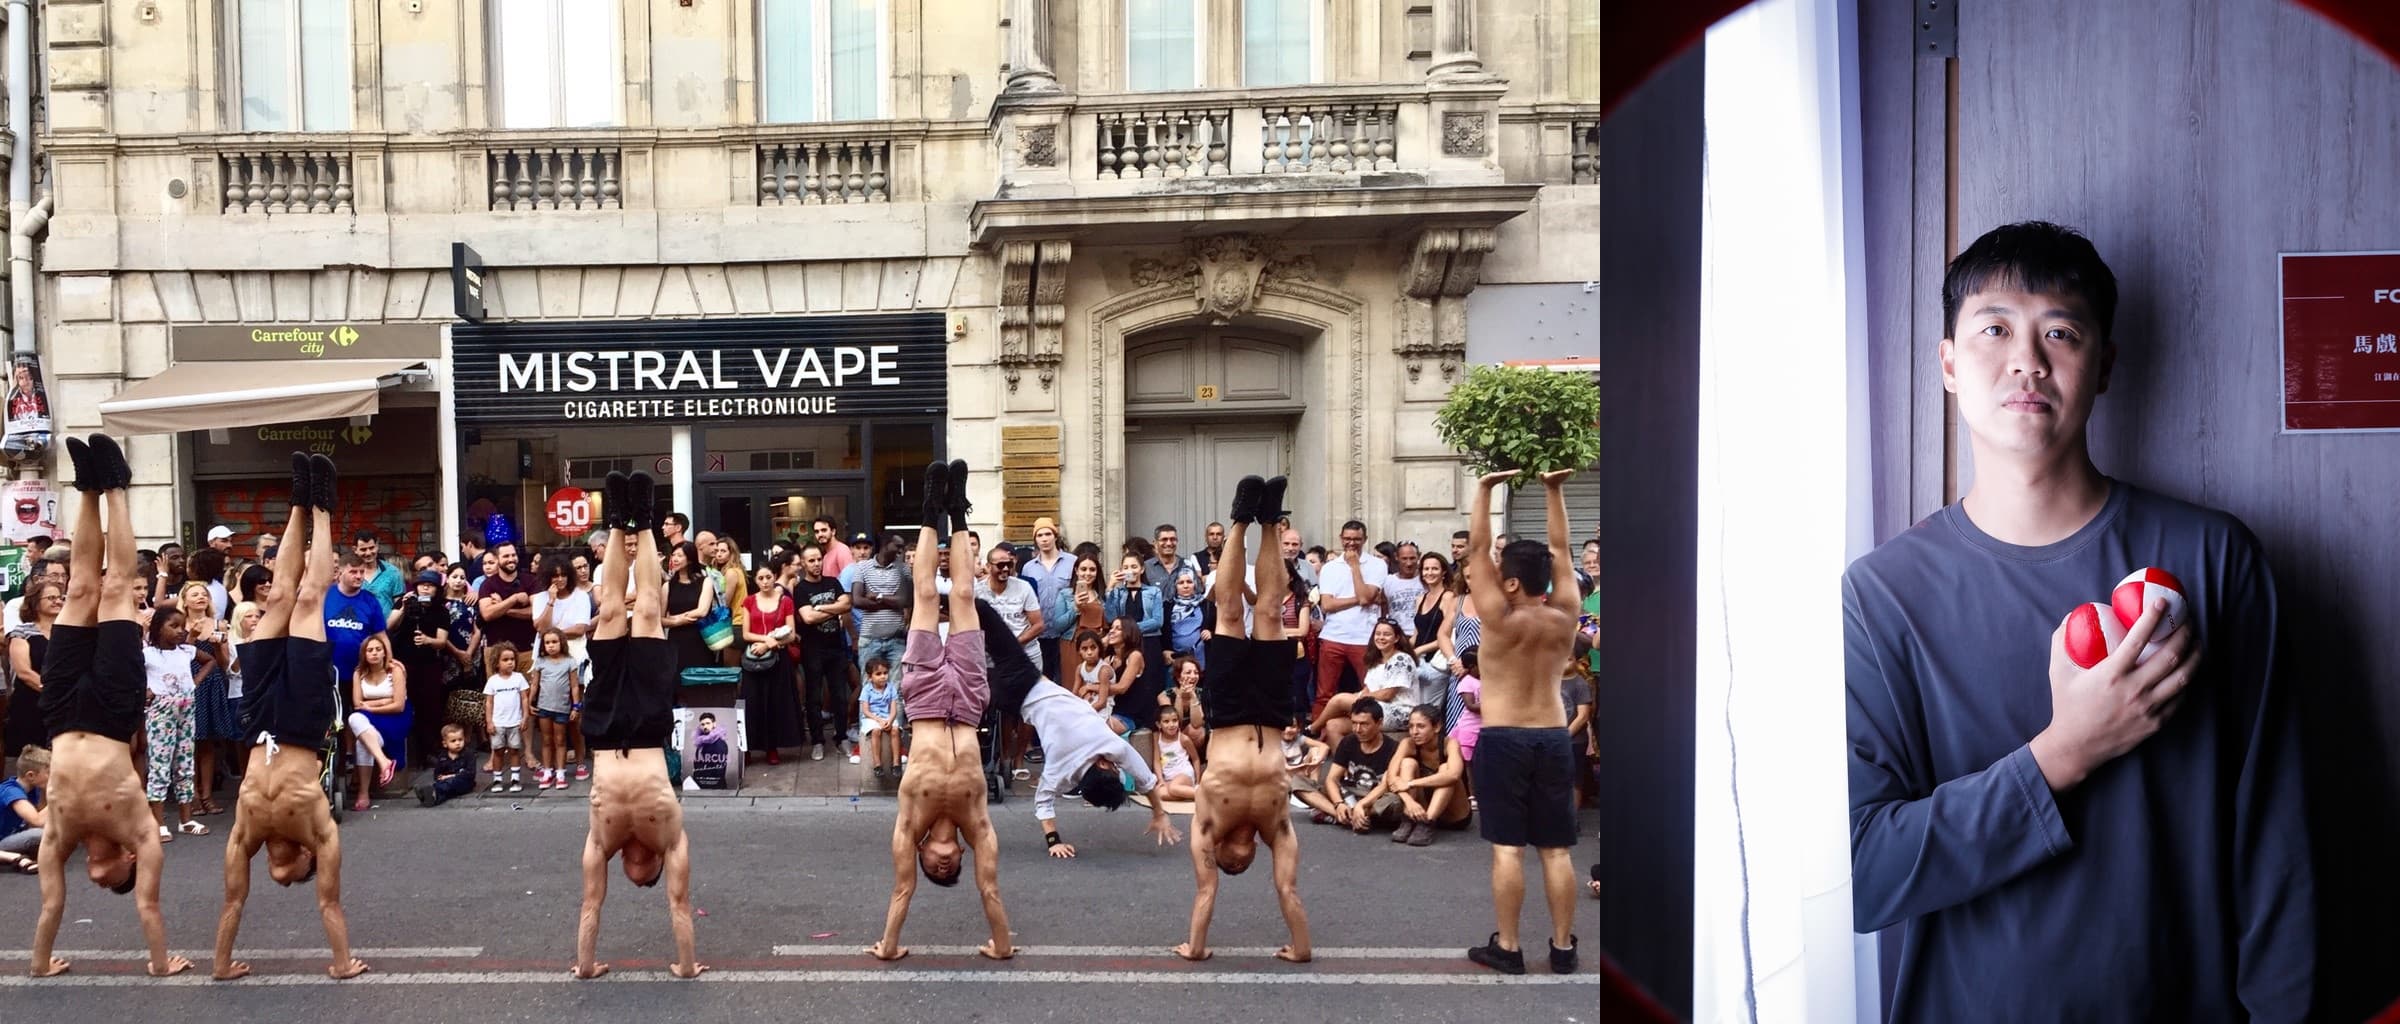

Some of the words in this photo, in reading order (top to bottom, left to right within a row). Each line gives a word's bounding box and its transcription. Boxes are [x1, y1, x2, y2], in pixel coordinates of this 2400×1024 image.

[252, 328, 324, 342] Carrefour
[300, 342, 325, 358] city
[499, 350, 739, 394] MISTRAL
[753, 345, 900, 388] VAPE
[1201, 386, 1213, 398] 23
[564, 399, 675, 419] CIGARETTE
[684, 396, 837, 416] ELECTRONIQUE
[257, 426, 335, 441] Carrefour
[309, 442, 335, 456] city
[327, 618, 364, 630] adidas
